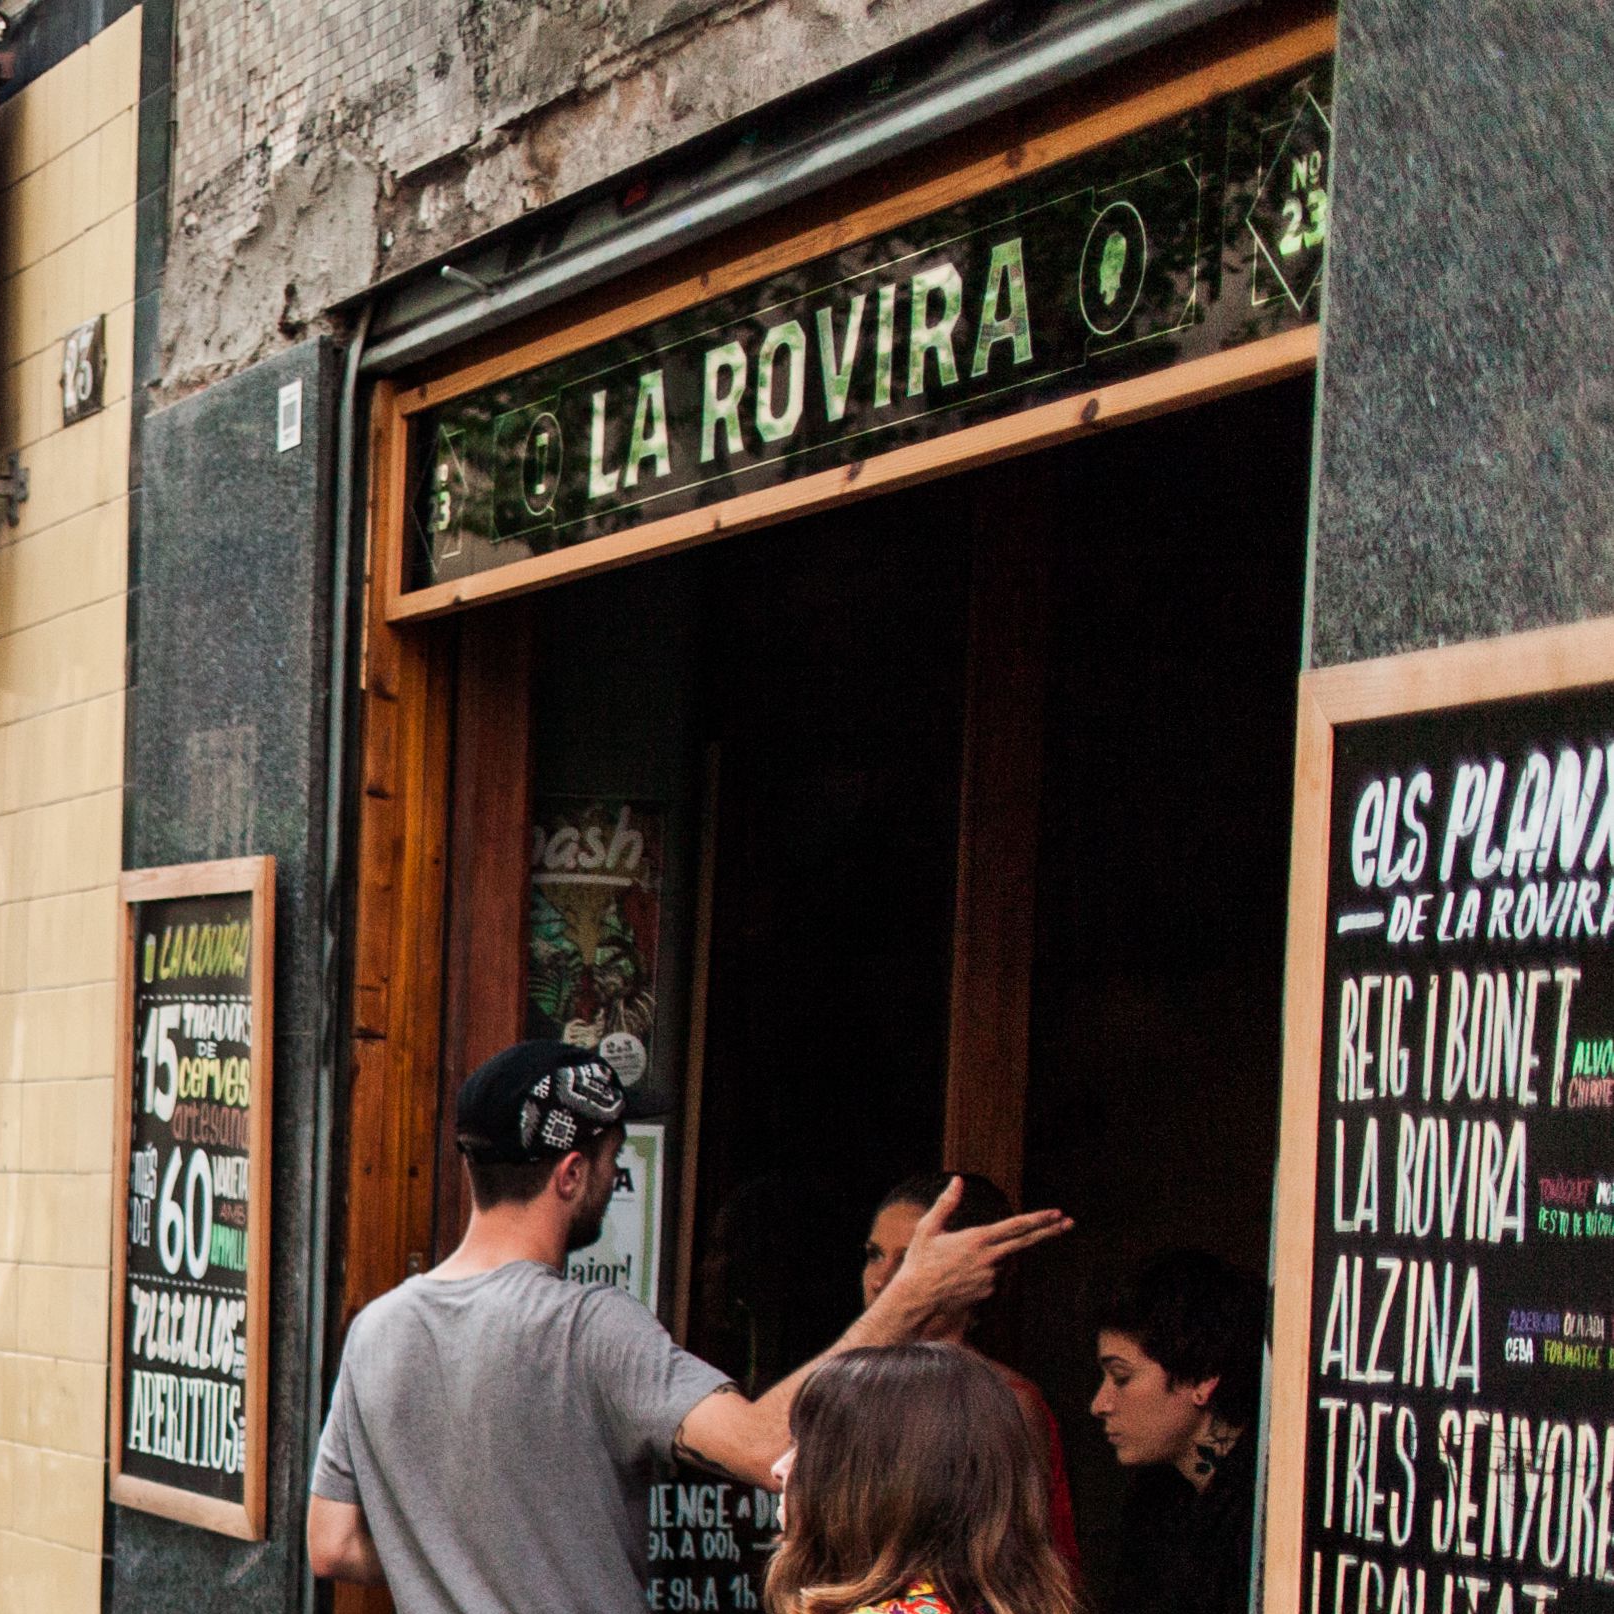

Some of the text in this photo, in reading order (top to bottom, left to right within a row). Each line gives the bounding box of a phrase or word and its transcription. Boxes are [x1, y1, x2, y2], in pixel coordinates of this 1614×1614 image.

[1279, 189, 1328, 256] 23
[588, 237, 1033, 499] LA ROVIRA
[1386, 894, 1434, 943] DE
[1436, 888, 1482, 941] LA
[141, 1003, 182, 1123] 15
[197, 1041, 218, 1059] DE
[1337, 973, 1414, 1102] REIG
[1442, 968, 1581, 1107] BONET
[1571, 1039, 1614, 1079] ALVO
[158, 1146, 213, 1280] 60
[1334, 1112, 1527, 1243] LA ROVIRA
[1320, 1253, 1482, 1393] ALZINA
[1504, 1336, 1534, 1364] CEBA
[128, 1369, 242, 1475] APERITIUS
[1318, 1397, 1419, 1548] TRES
[668, 1577, 700, 1611] 9h
[703, 1576, 720, 1611] A
[729, 1573, 758, 1610] 1h
[680, 1530, 697, 1561] A
[702, 1530, 741, 1563] 00h
